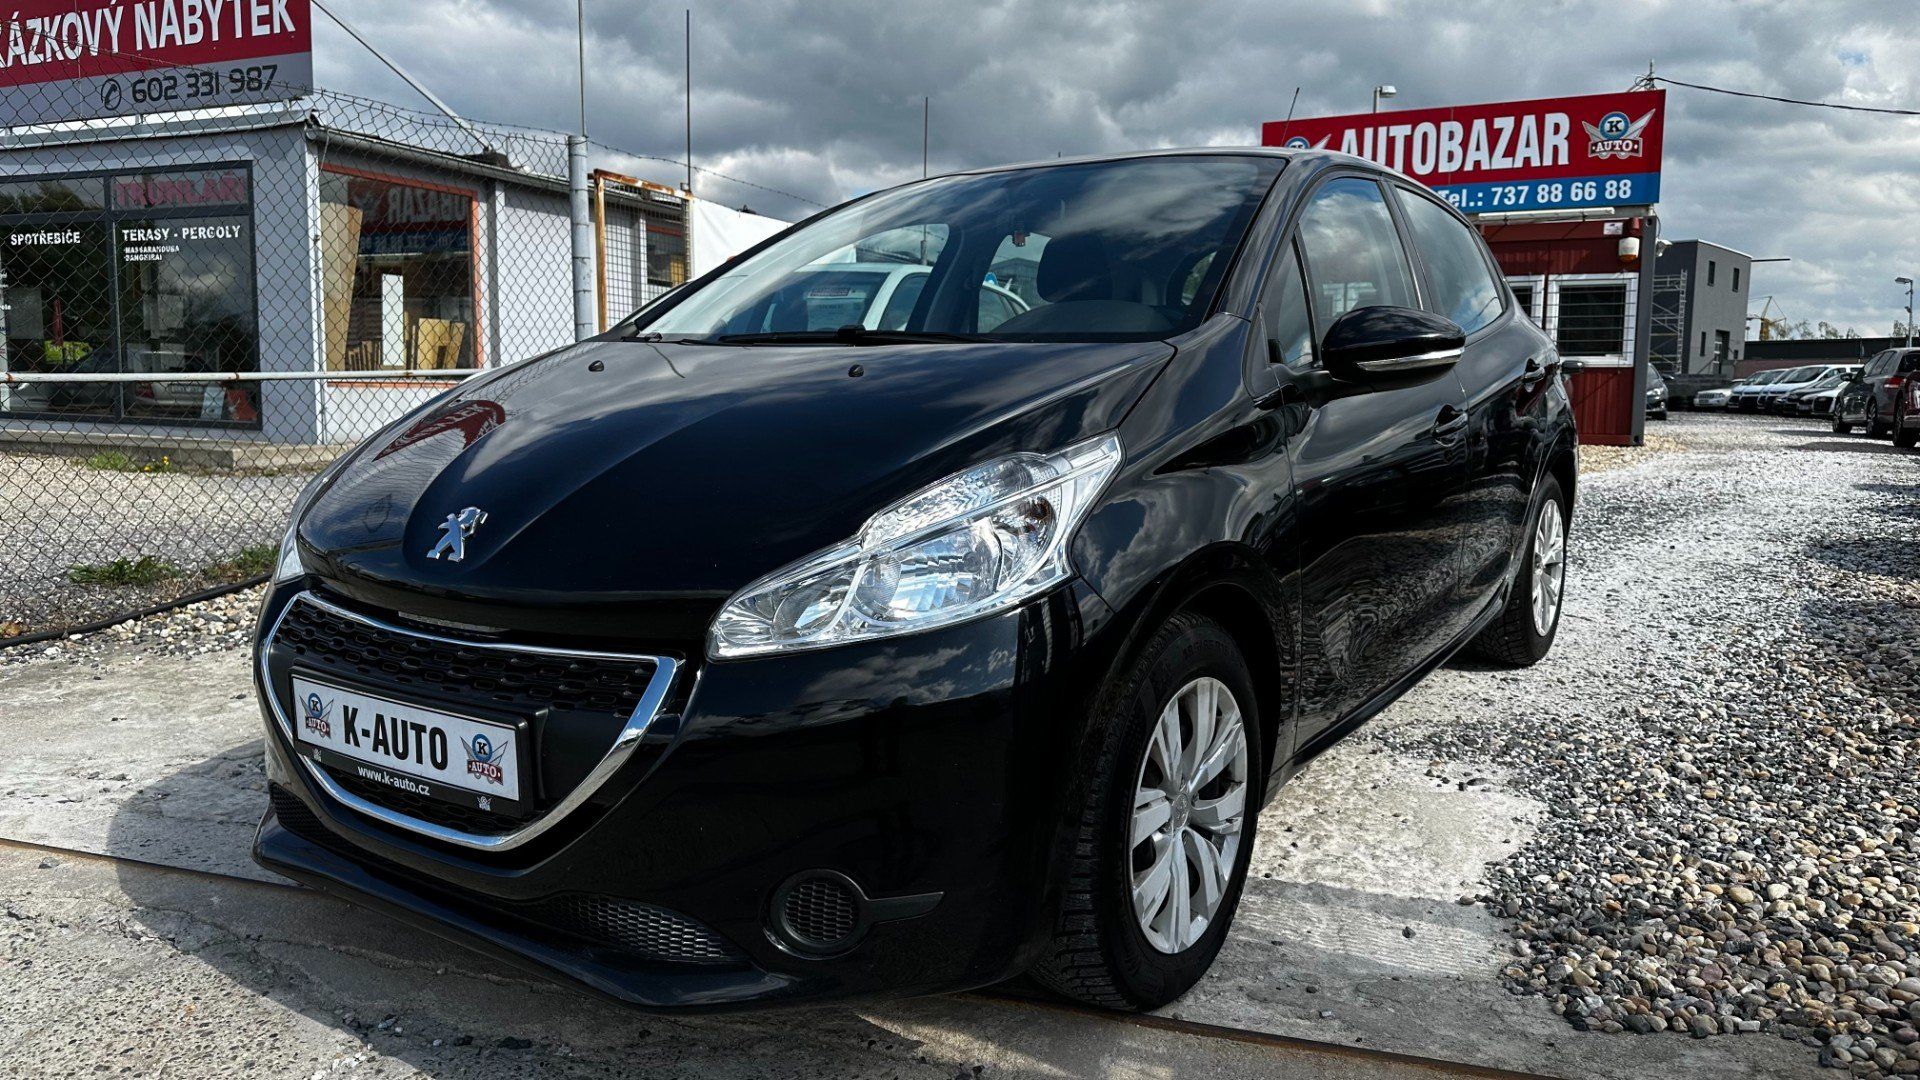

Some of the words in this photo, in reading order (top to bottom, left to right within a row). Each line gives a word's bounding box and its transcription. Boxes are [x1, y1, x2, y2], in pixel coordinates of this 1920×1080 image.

[131, 75, 178, 103] 602
[186, 71, 220, 98] 331
[229, 64, 278, 94] 987
[1607, 120, 1622, 133] K
[1340, 112, 1570, 176] AUTOBAZAR
[1596, 140, 1633, 152] AUTO
[1491, 185, 1529, 206] 737
[1537, 183, 1563, 203] 88
[1570, 181, 1597, 201] 66
[1605, 179, 1632, 200] 88
[10, 229, 81, 246] SPOTŘEBIČE
[122, 228, 170, 241] TERASY
[182, 225, 241, 239] PERGOLY
[343, 705, 448, 771] K-AUTO
[476, 741, 489, 756] K
[471, 761, 497, 778] AUTO
[357, 766, 431, 796] www.k-auto.cz
